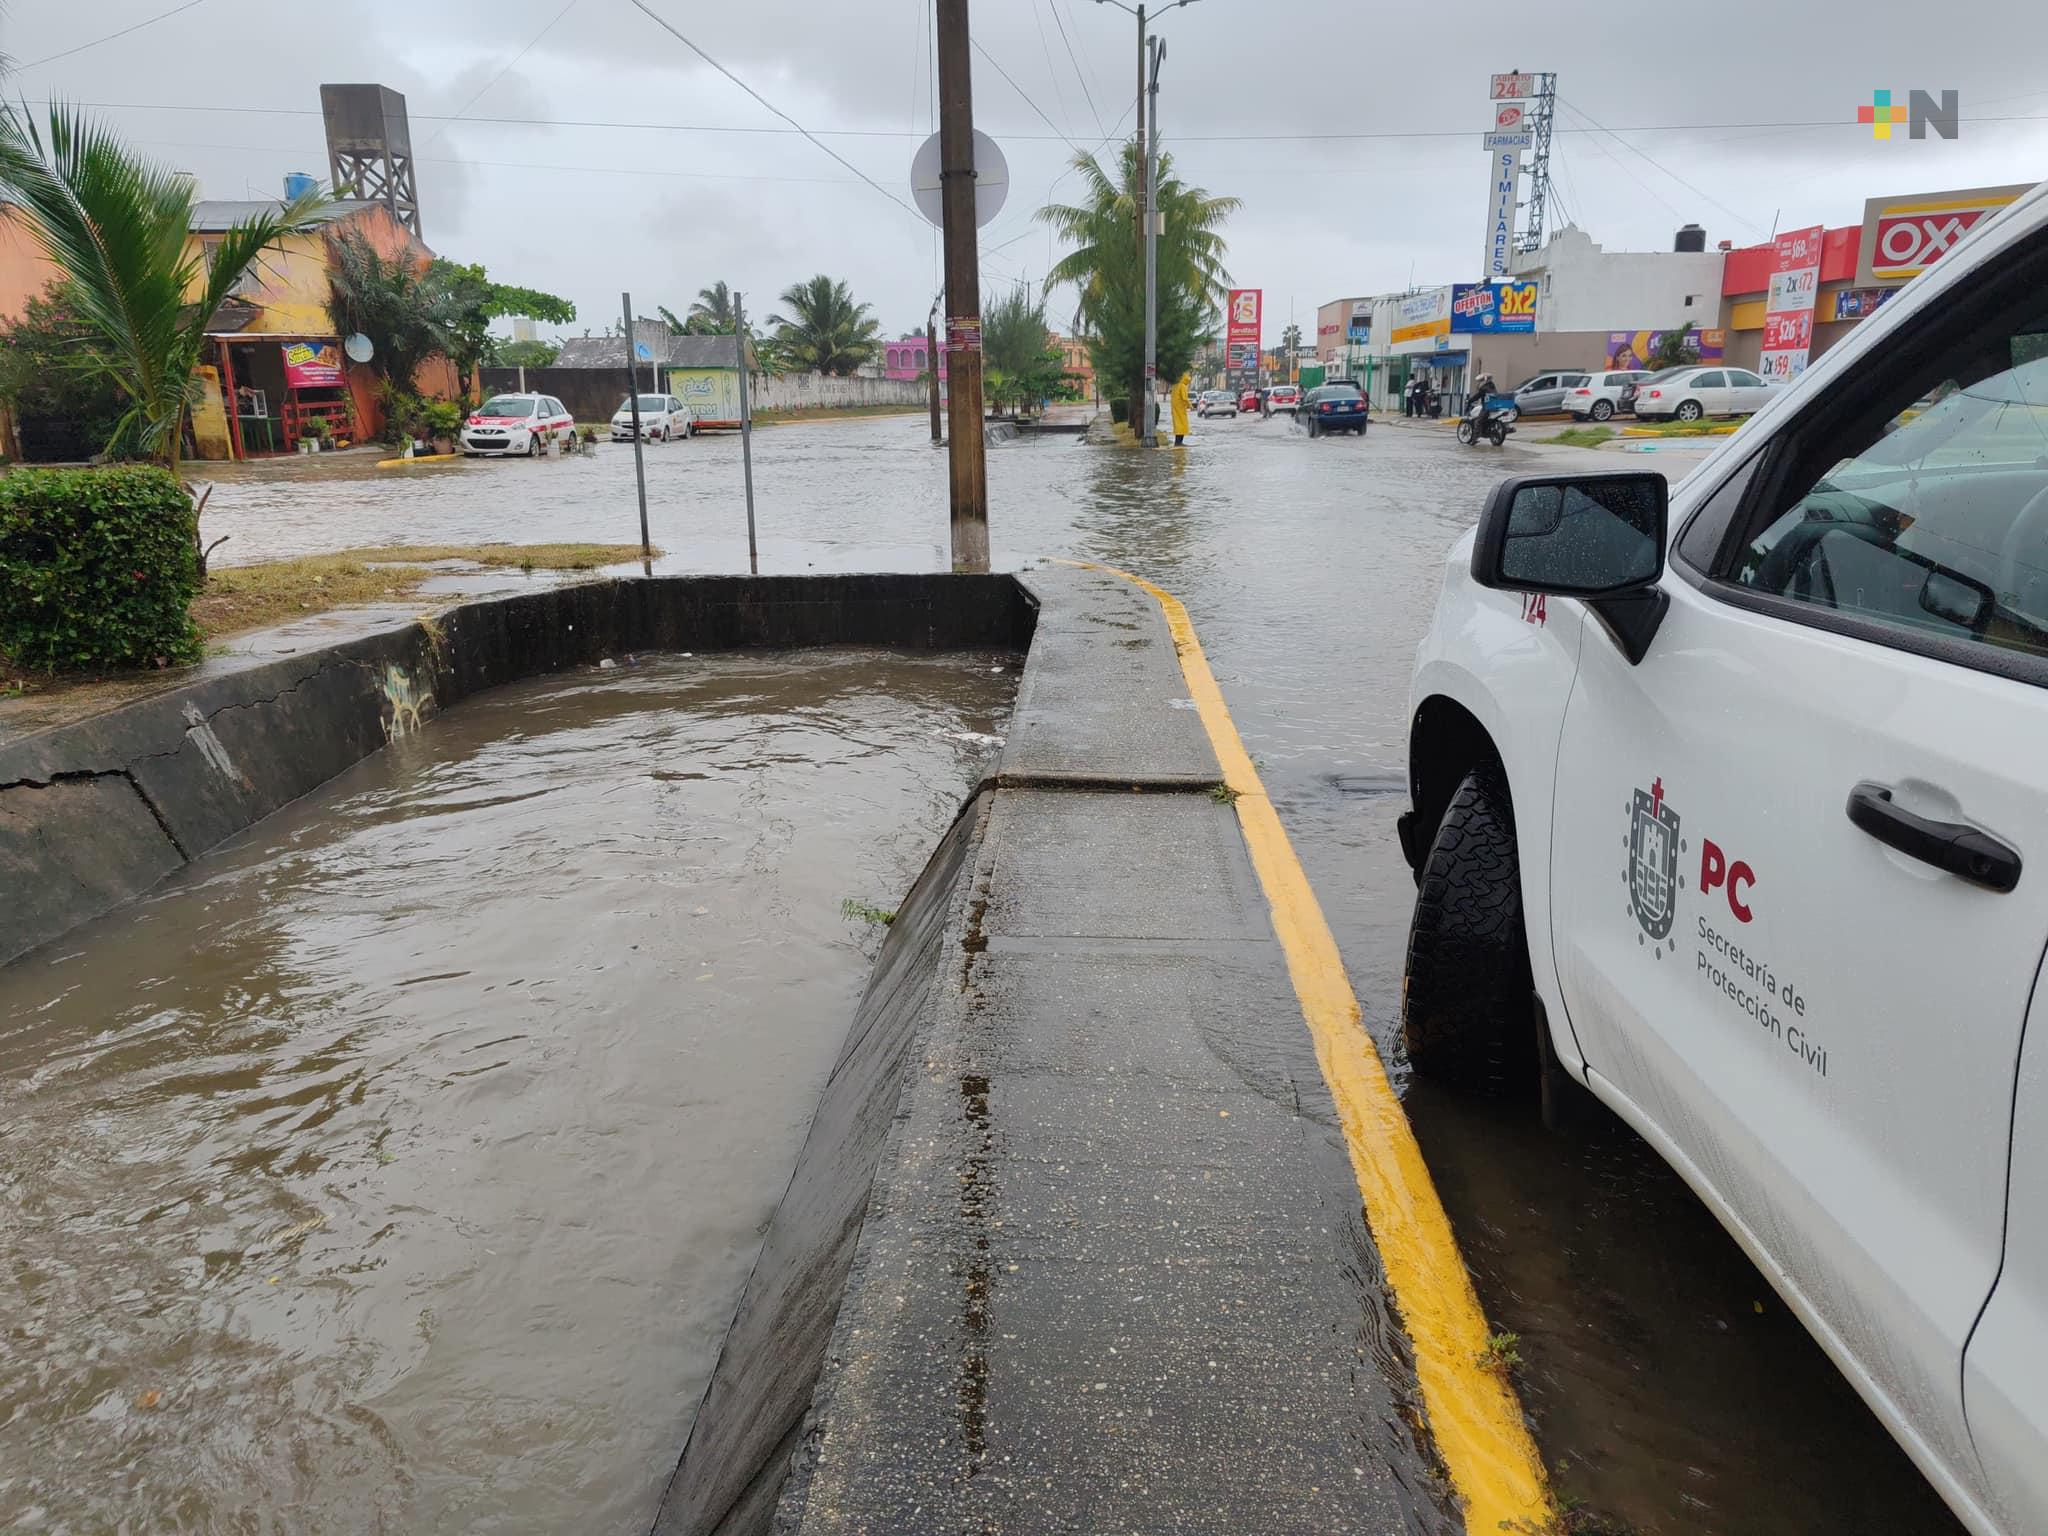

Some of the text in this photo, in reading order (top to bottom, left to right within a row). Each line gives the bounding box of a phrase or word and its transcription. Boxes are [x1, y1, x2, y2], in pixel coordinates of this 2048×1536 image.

[1488, 135, 1530, 146] FARMACIAS
[1493, 154, 1513, 272] SIMILARES
[1881, 217, 1975, 262] OX
[1700, 838, 1756, 923] PC
[1698, 915, 1806, 1017] Secretaría de
[1697, 951, 1827, 1077] Protección Civil
